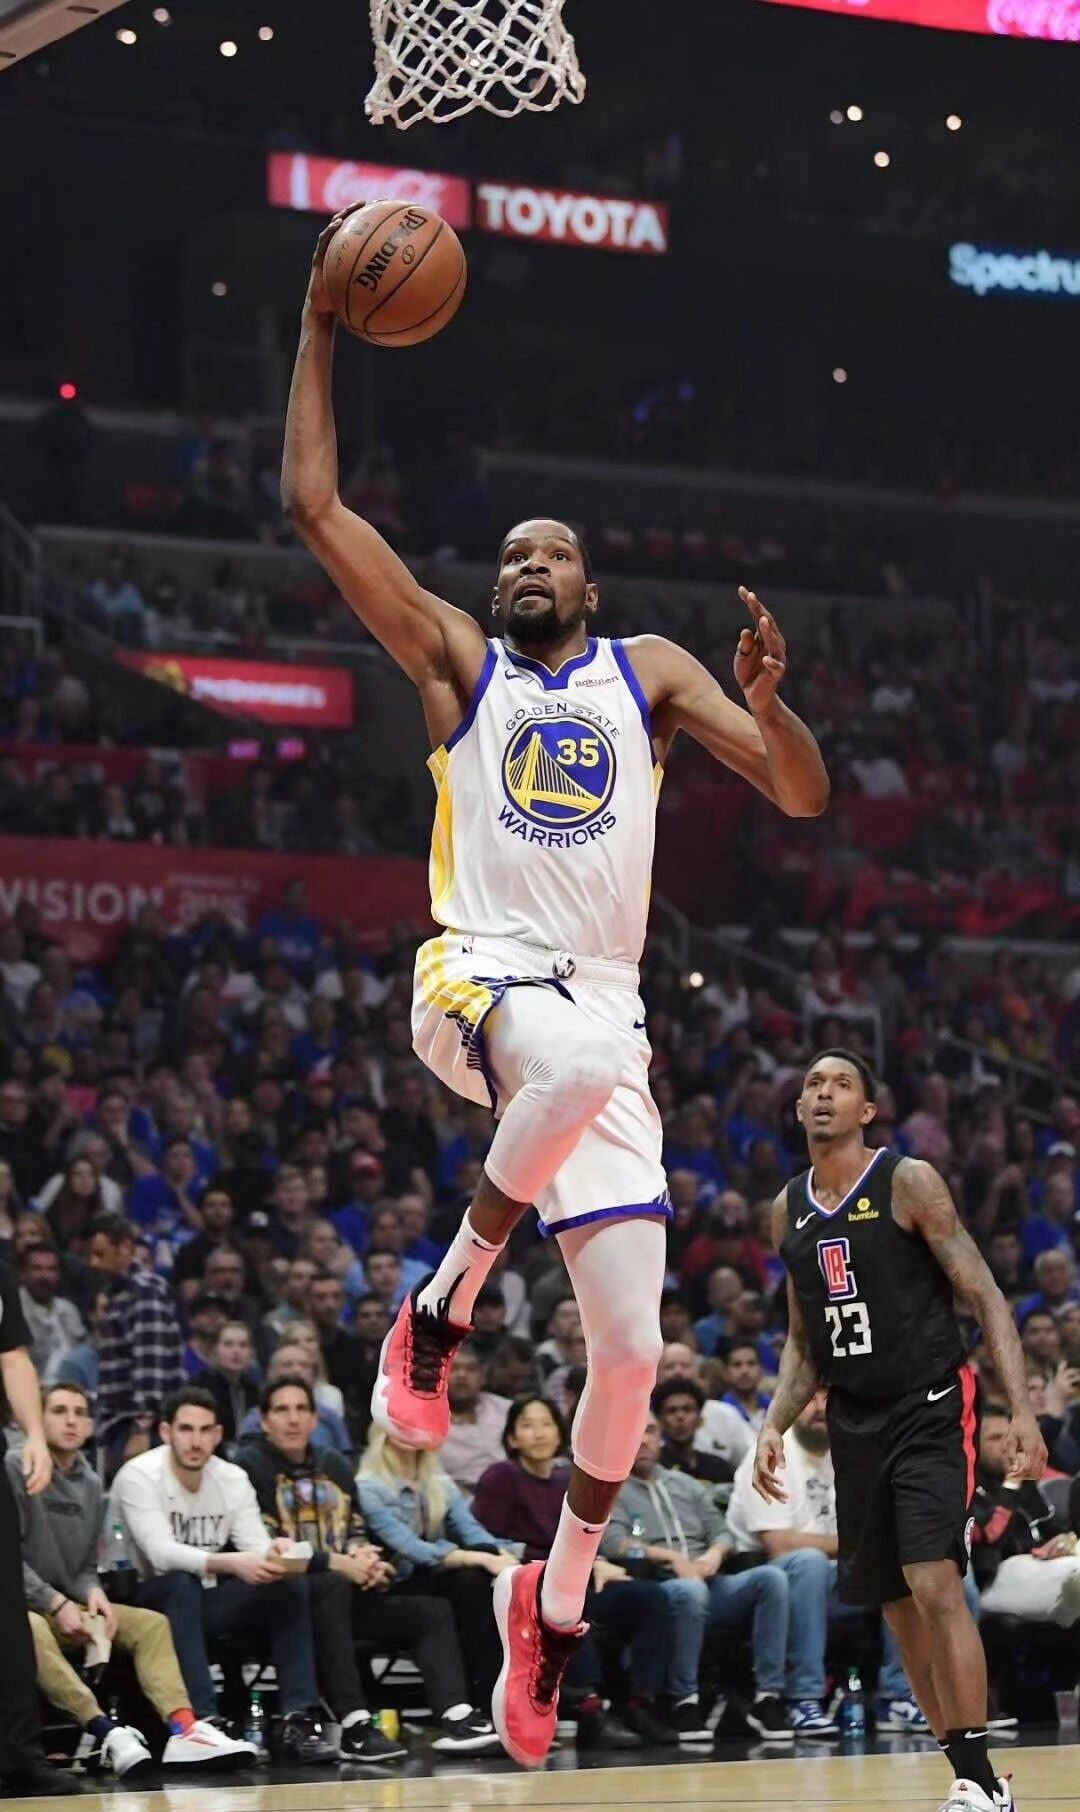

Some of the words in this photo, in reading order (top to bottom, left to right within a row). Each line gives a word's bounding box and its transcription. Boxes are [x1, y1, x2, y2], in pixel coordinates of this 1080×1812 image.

[477, 183, 668, 252] TOYOTA
[352, 208, 428, 293] SPDING
[506, 702, 568, 731] GOLDEN
[574, 708, 620, 740] STATE
[556, 738, 600, 768] 35
[498, 804, 617, 849] WARRIORS
[848, 1209, 879, 1222] bumble
[824, 1302, 873, 1357] 23
